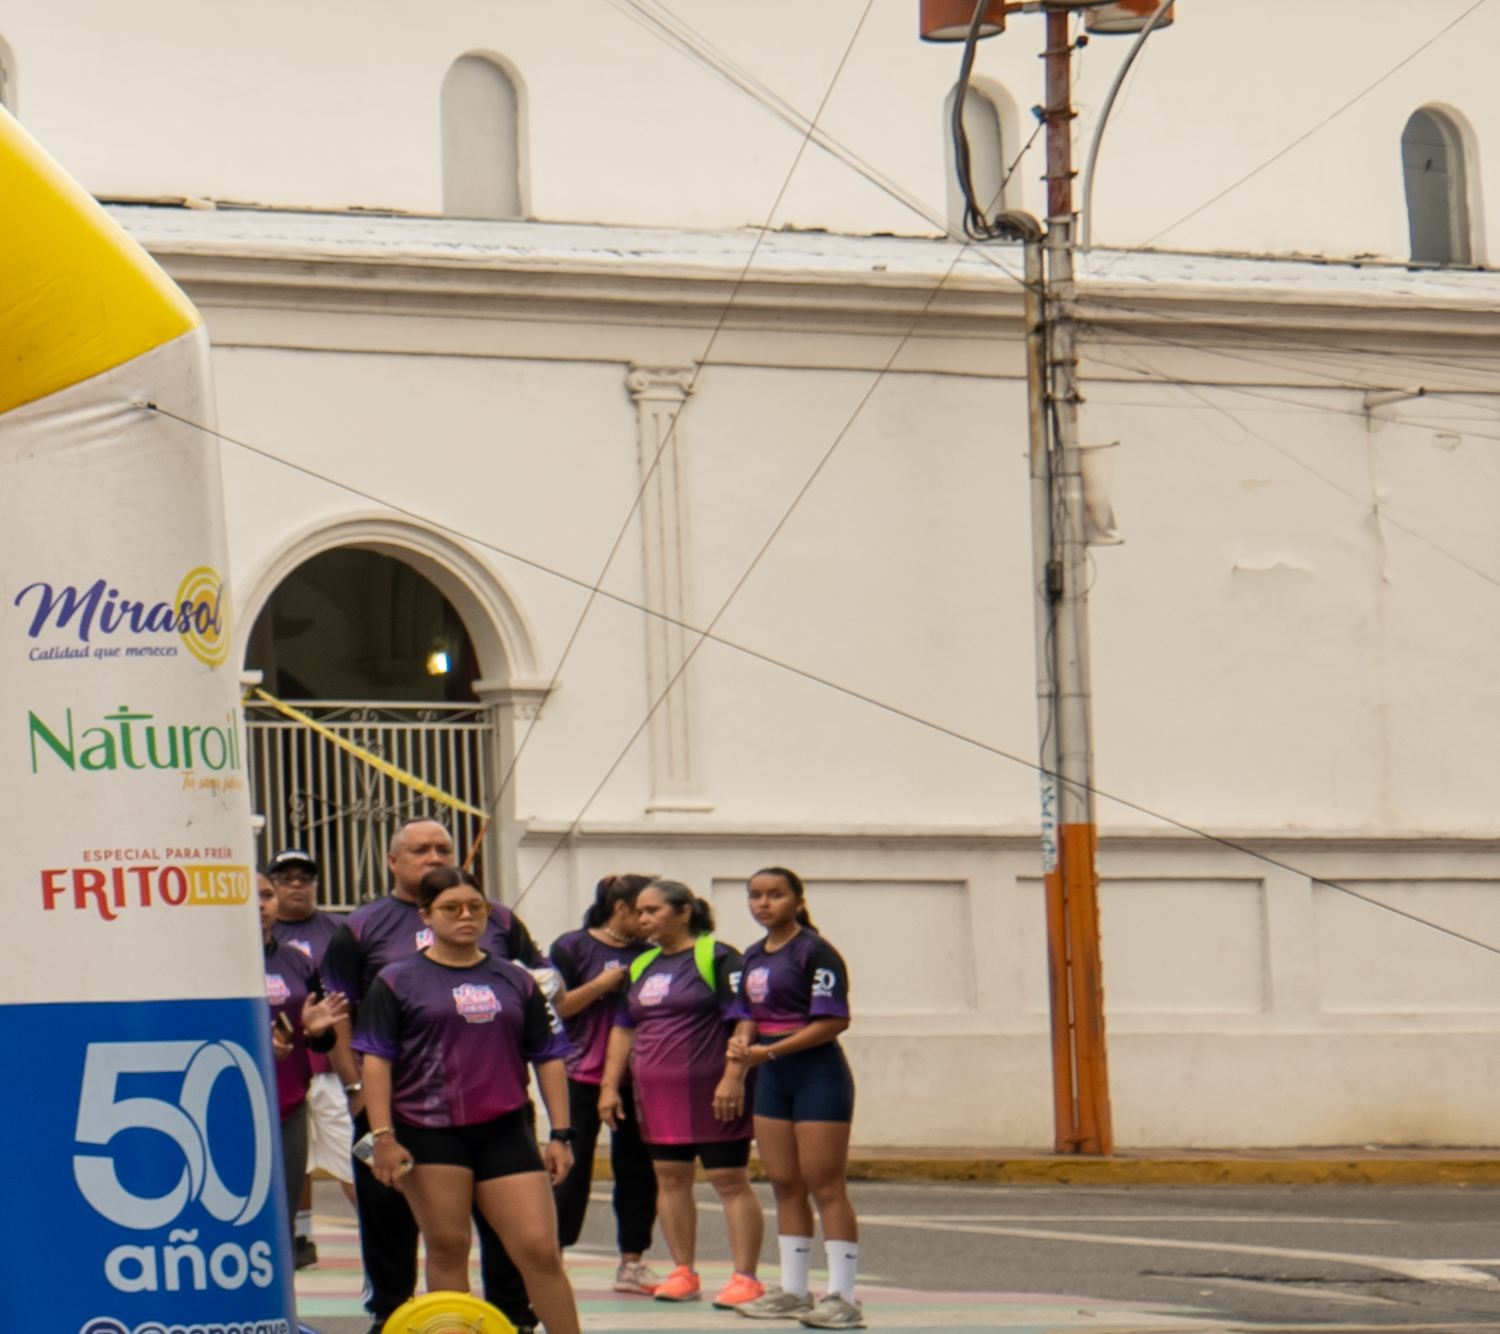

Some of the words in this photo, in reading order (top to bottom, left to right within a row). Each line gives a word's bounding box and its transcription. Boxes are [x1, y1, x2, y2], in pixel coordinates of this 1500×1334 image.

[13, 578, 225, 643] Mirasol
[28, 646, 90, 662] Calidad
[93, 647, 121, 661] que
[27, 705, 241, 774] Naturoil
[82, 847, 160, 862] ESPECIAL
[165, 846, 201, 860] PARA
[40, 866, 188, 922] FRITO
[72, 1039, 273, 1231] 50
[104, 1228, 274, 1293] años
